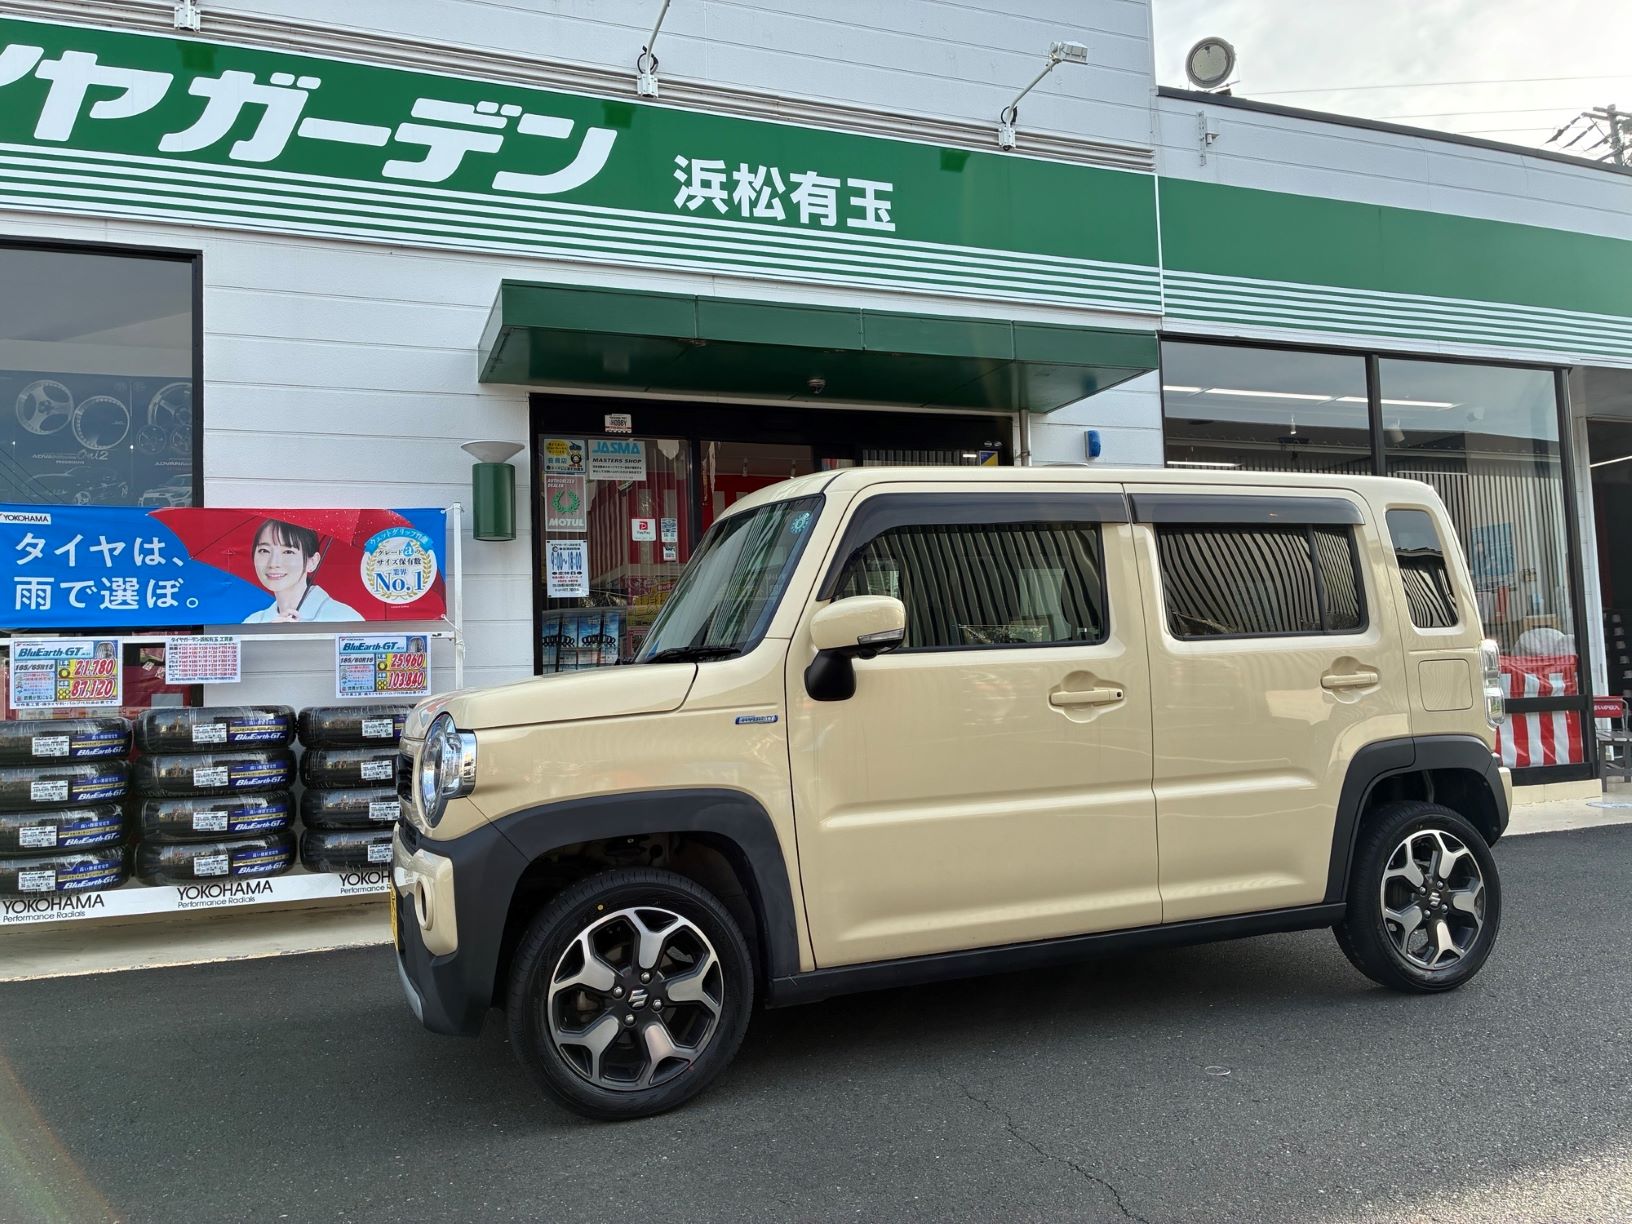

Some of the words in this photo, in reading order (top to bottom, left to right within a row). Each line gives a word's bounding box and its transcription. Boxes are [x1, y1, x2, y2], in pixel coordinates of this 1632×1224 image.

[673, 154, 896, 232] 浜松有玉
[592, 441, 641, 454] JASMA
[3, 513, 49, 523] YOKOHAMA
[549, 518, 584, 527] MOTUL
[15, 532, 184, 568] タイヤは、
[377, 557, 422, 566] サイズ保有数
[374, 571, 423, 592] No.1
[13, 577, 199, 610] 雨で選ぼ。
[18, 647, 84, 657] BluEarth-GT
[343, 642, 398, 651] BluEarth-GT
[234, 733, 281, 741] BluEarth-GT
[77, 746, 123, 756] BluEarth-GT
[236, 776, 282, 786] BluEarth-GT
[78, 789, 123, 800] BluEarth-GT
[234, 820, 281, 831] BluEarth-GT
[64, 832, 116, 846] BluEarth-GT
[237, 862, 284, 874] BluEarth-GT
[63, 875, 116, 890] BluEarth-GT
[177, 880, 273, 901] YOKOHAMA
[340, 885, 385, 894] Performance
[2, 894, 105, 915] YOKOHAMA
[178, 900, 227, 908] Performance
[228, 896, 256, 904] Radials
[3, 913, 55, 923] Performance
[56, 910, 86, 918] Radials
